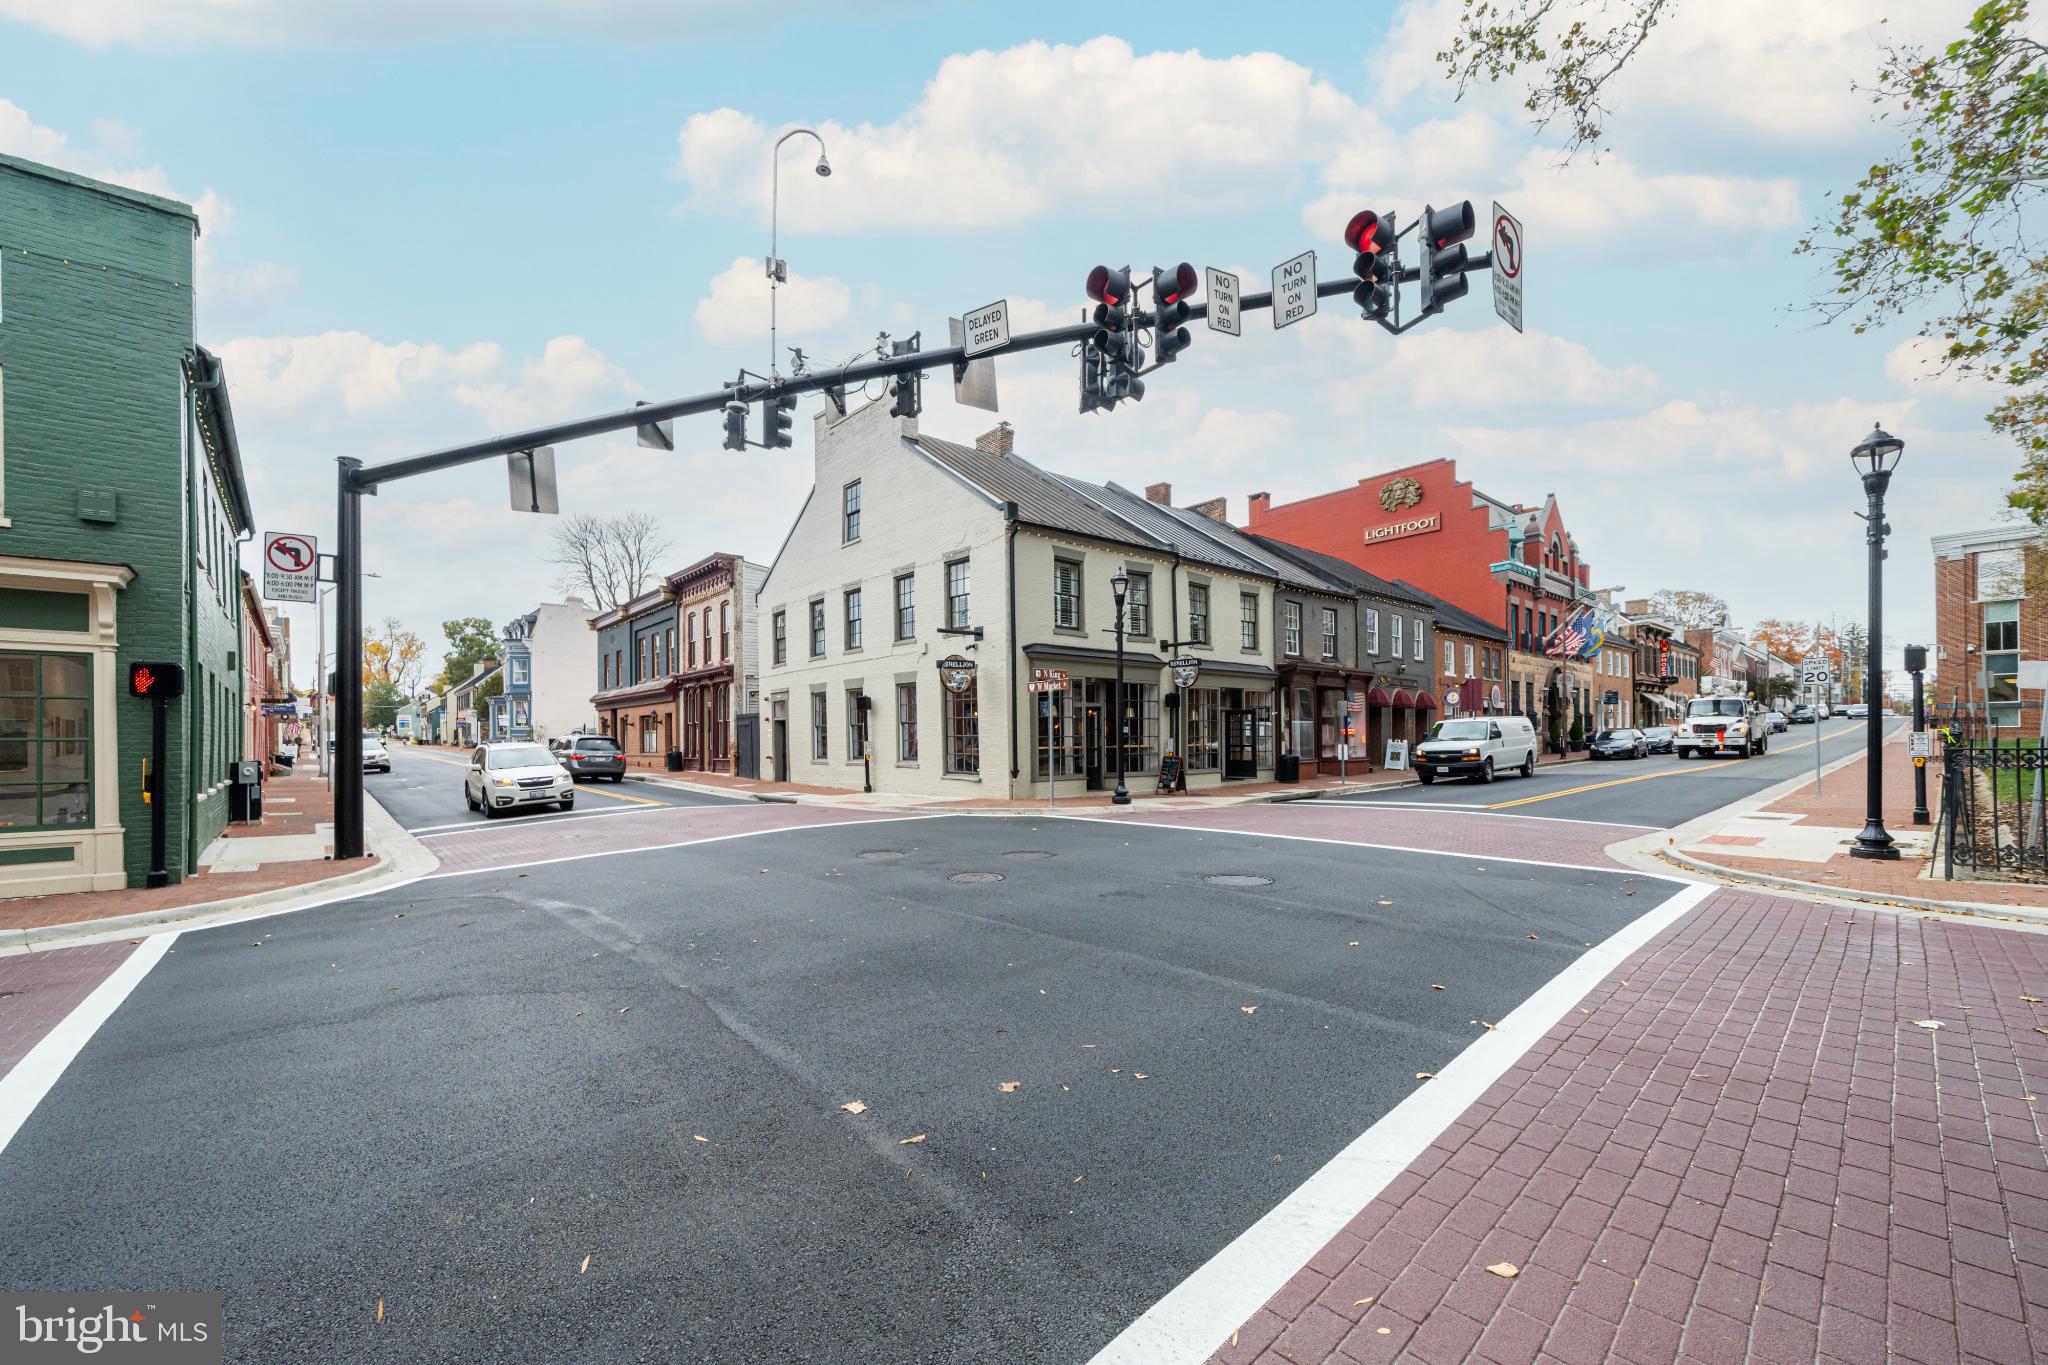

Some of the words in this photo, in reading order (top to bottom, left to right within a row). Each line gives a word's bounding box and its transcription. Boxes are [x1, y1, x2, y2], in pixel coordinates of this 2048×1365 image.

[1283, 261, 1303, 279] NO
[1215, 274, 1230, 289] NO
[1281, 275, 1307, 294] TURN
[1213, 289, 1233, 303] TURN
[1287, 291, 1301, 305] ON
[1218, 304, 1230, 316] ON
[1285, 305, 1304, 320] RED
[968, 310, 1002, 331] DELAYED
[1217, 316, 1232, 329] RED
[974, 328, 999, 345] GREEN
[1365, 516, 1437, 540] LIGHTFOOT
[1804, 671, 1828, 682] 20
